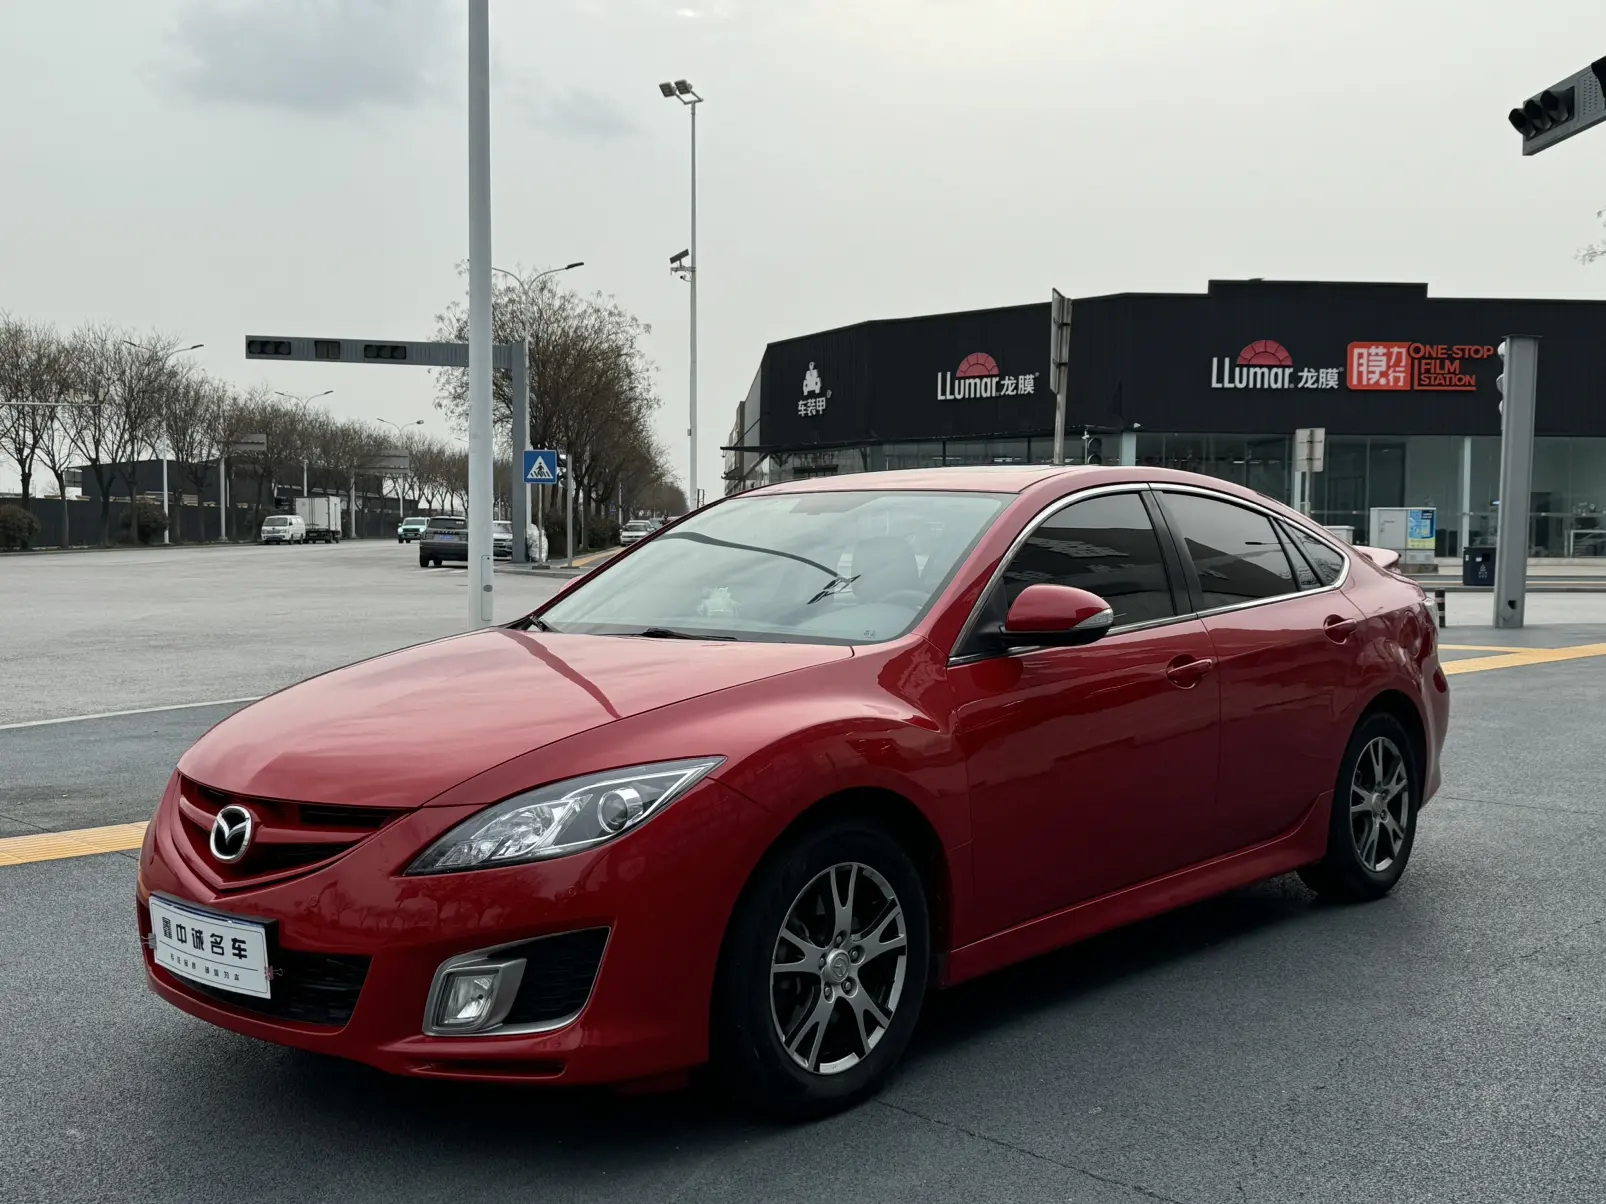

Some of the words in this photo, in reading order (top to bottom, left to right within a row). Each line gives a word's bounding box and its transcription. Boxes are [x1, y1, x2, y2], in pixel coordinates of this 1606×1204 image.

[1408, 342, 1494, 359] ONE-STOP
[1211, 357, 1293, 389] LLumar
[1297, 367, 1339, 389] 龙膜
[1421, 359, 1460, 374] FILM
[937, 371, 999, 400] LLumar
[1000, 374, 1035, 395] 龙膜
[1420, 374, 1476, 386] STATION
[797, 397, 826, 417] 车装甲
